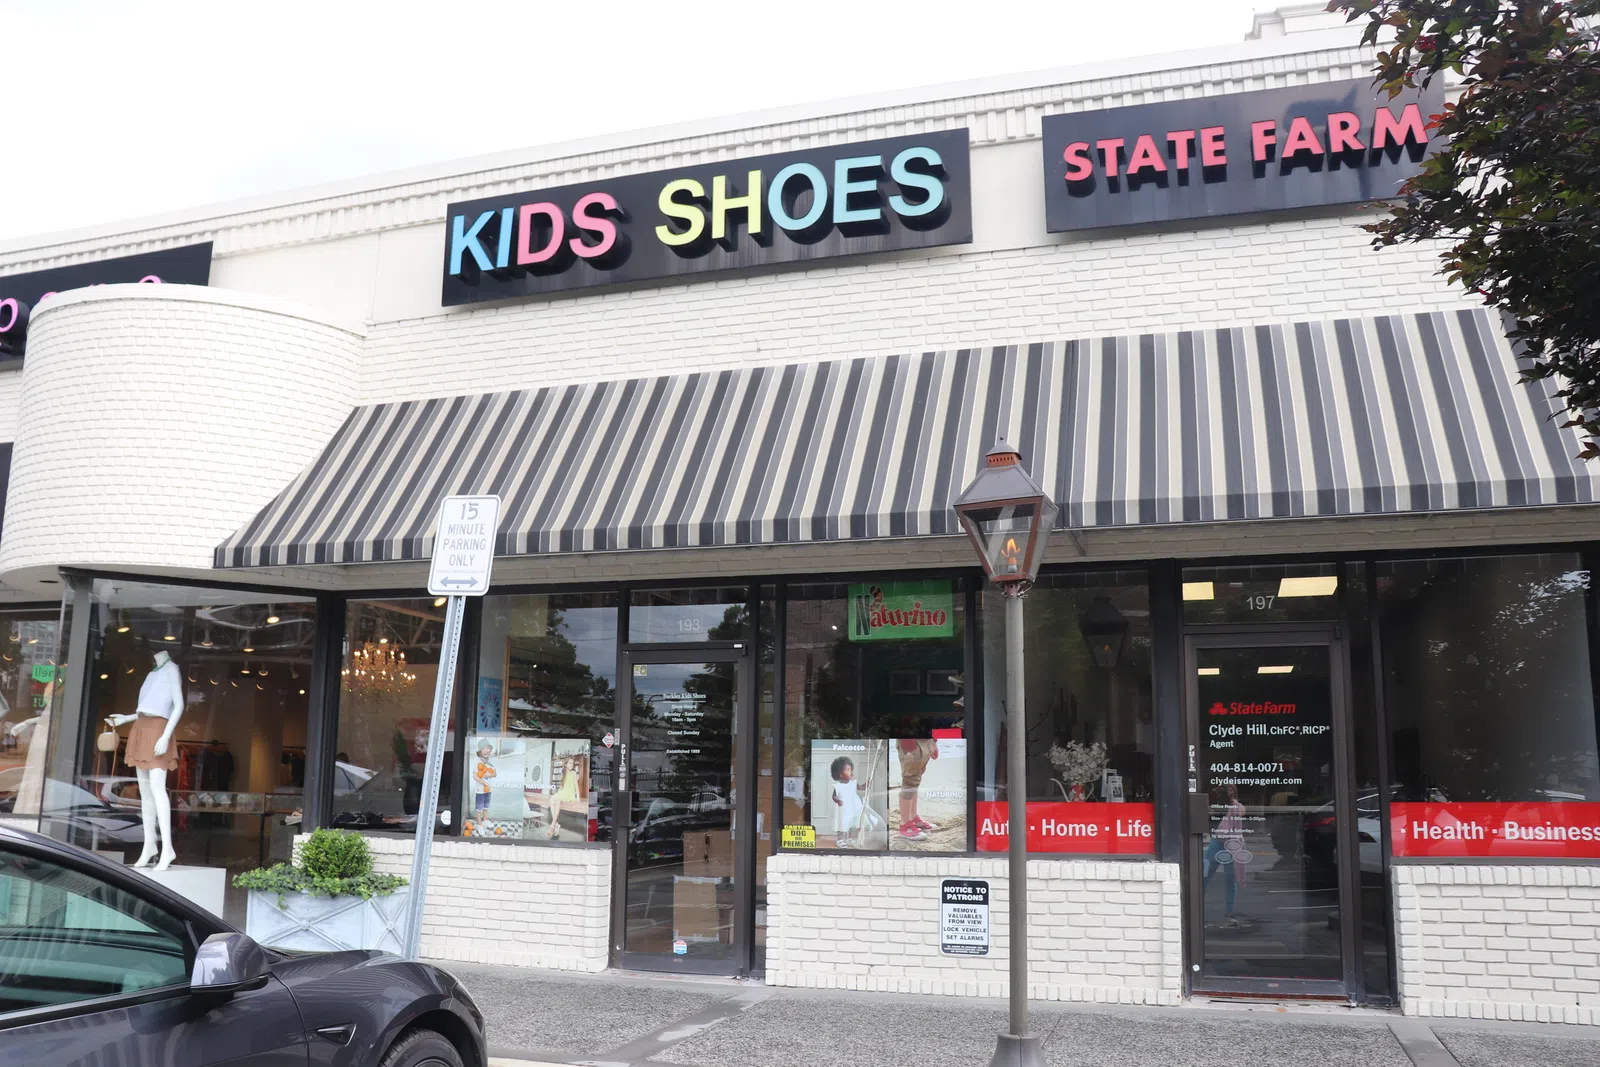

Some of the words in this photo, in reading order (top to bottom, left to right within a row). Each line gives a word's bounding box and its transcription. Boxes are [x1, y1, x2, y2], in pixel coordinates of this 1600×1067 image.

[1063, 125, 1227, 182] STATE
[1250, 103, 1429, 162] FARM
[449, 191, 619, 276] KIDS
[654, 146, 945, 246] SHOES
[460, 502, 479, 520] 15
[447, 523, 486, 535] MINUTE
[443, 538, 487, 550] PARKING
[449, 553, 475, 566] ONLY
[1246, 595, 1275, 610] 197
[856, 594, 947, 636] Naturino
[677, 619, 700, 632] 193
[1209, 724, 1243, 737] Clyde
[832, 743, 865, 751] Falcotto
[1209, 740, 1234, 749] Agent
[1210, 762, 1284, 772] 404-814-0071
[1210, 777, 1303, 786] clydeismyagent.com
[980, 818, 1009, 836] Aut
[1041, 818, 1098, 837] Home
[1116, 819, 1152, 837] Life
[1412, 820, 1485, 840] Health
[783, 840, 814, 848] PREMISES
[944, 886, 973, 894] NOTICE
[946, 893, 984, 901] PATRONS
